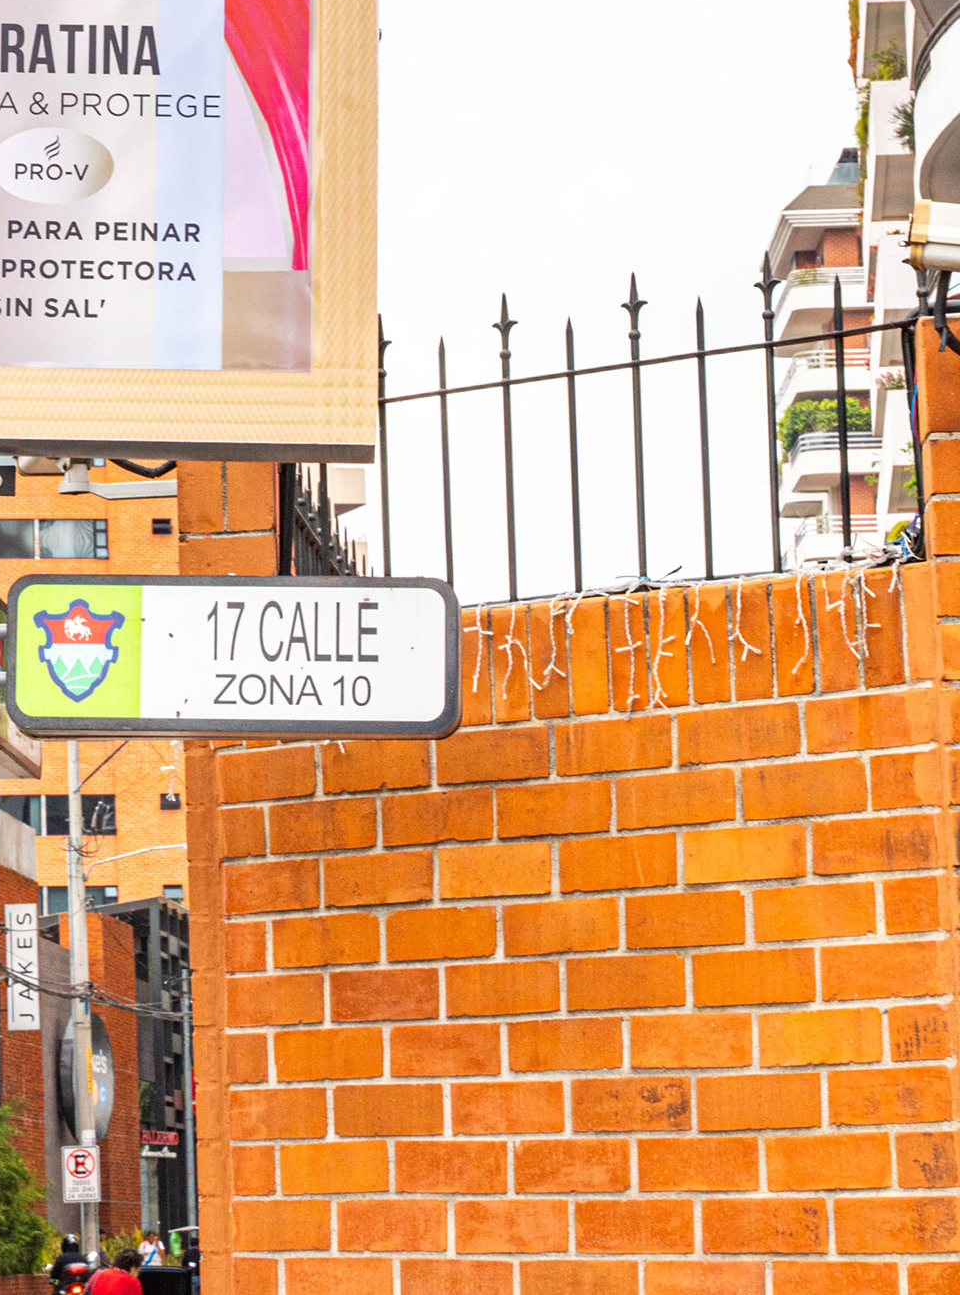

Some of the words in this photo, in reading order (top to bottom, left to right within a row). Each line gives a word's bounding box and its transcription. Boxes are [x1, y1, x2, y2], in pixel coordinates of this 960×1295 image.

[29, 91, 50, 116] &
[60, 92, 221, 118] PROTEGE
[14, 163, 89, 181] PRO-V
[7, 220, 83, 241] PARA
[95, 221, 201, 243] PEINAR
[207, 601, 245, 661] 17
[259, 601, 379, 662] CALLE
[213, 674, 323, 706] ZONA
[332, 675, 371, 706] 10
[16, 912, 35, 1022] JAKES
